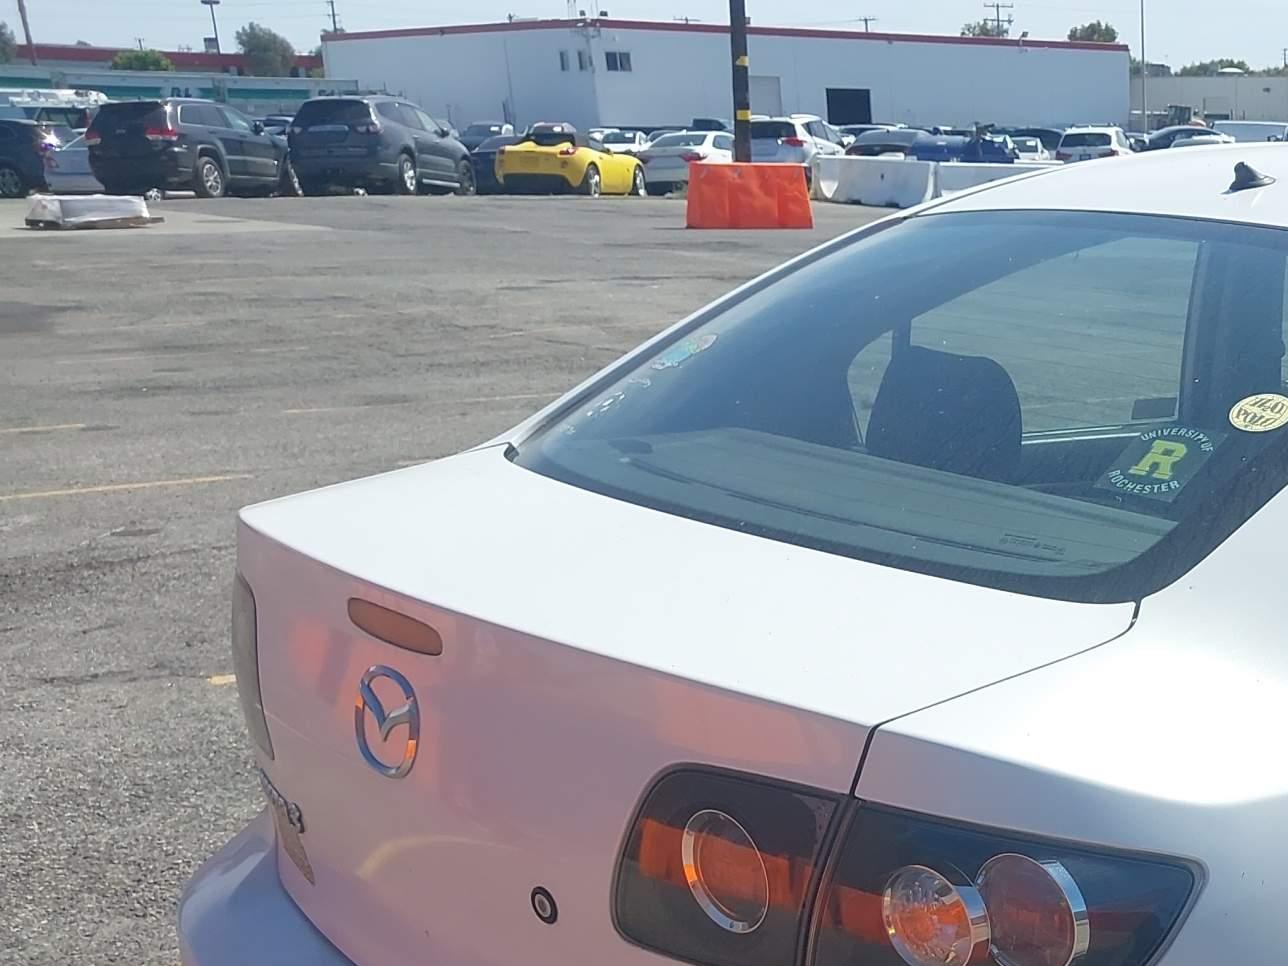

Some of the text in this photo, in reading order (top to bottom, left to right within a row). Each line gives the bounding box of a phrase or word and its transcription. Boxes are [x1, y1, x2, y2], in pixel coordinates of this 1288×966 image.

[1235, 407, 1278, 427] POLO
[1140, 427, 1211, 446] UNIVERSITY
[1128, 439, 1188, 480] R
[1107, 469, 1180, 494] ROCHESTER
